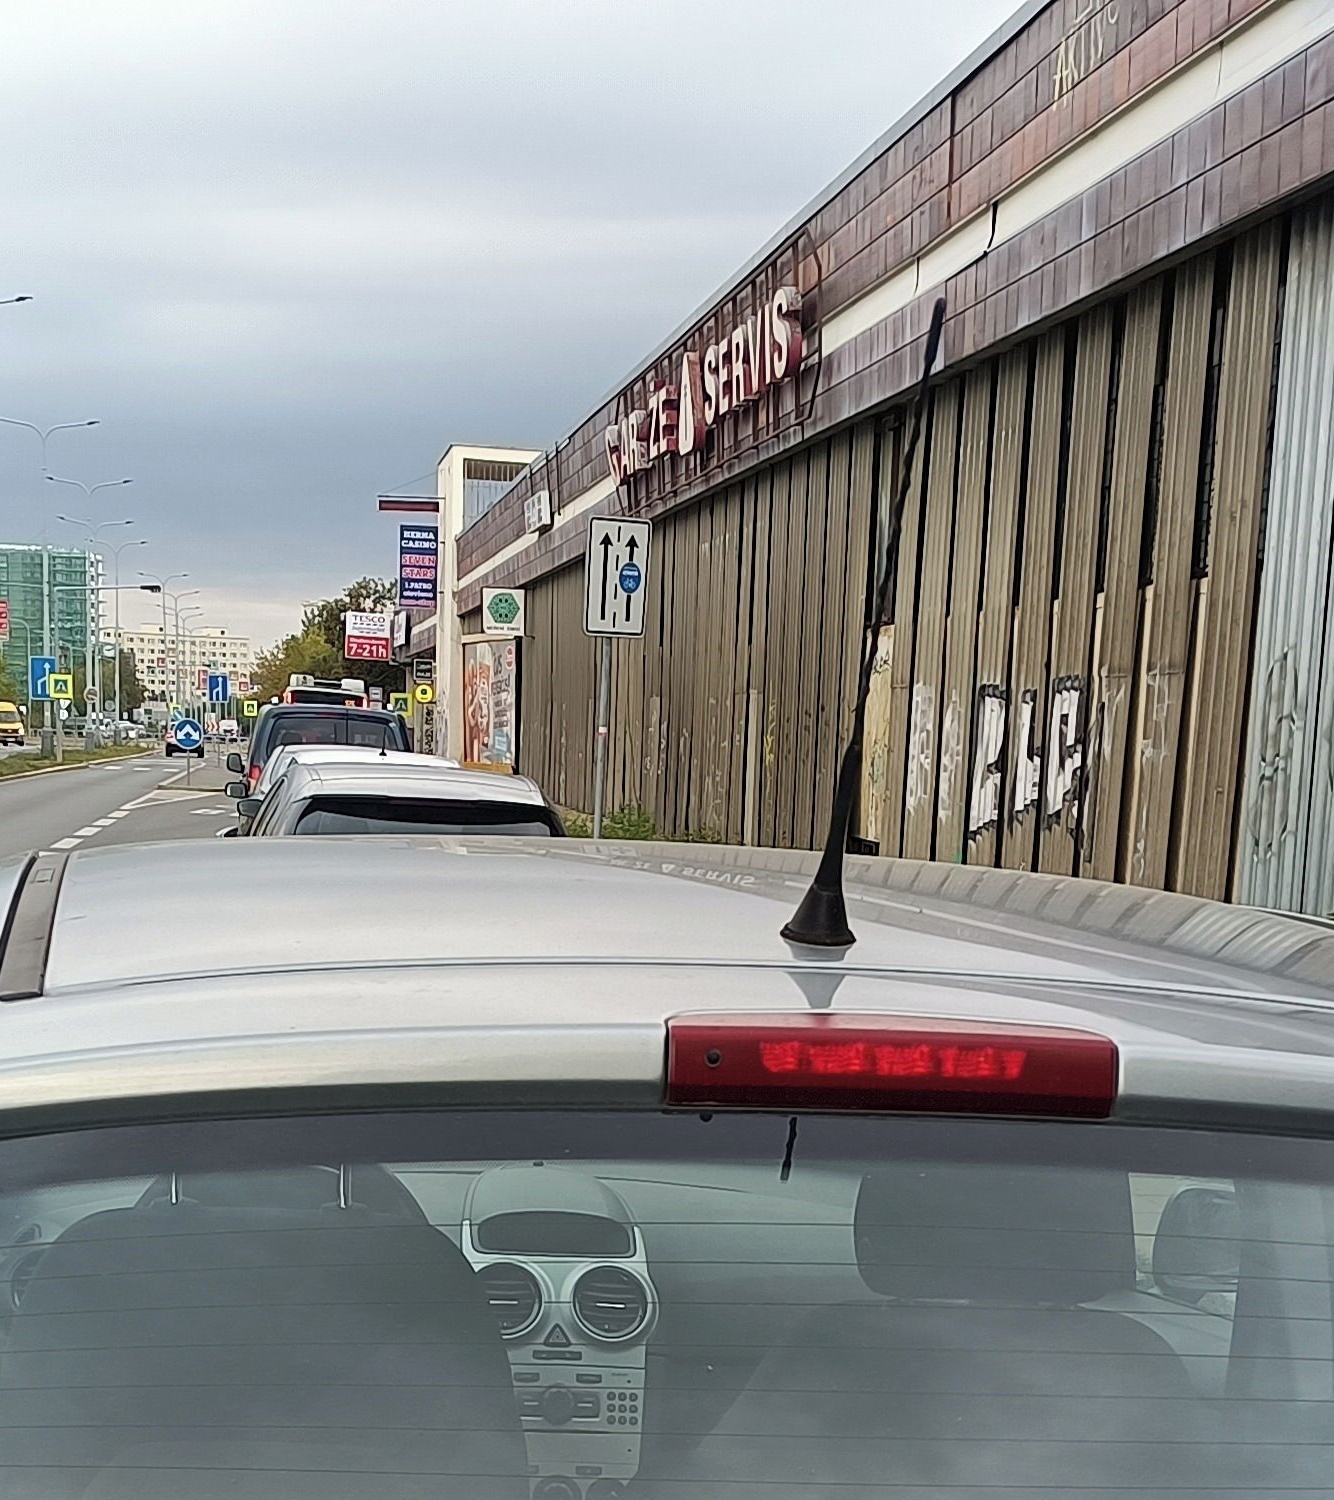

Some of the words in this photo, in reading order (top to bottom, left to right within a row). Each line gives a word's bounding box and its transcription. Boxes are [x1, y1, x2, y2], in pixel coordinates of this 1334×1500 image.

[704, 285, 800, 426] SERVIS
[403, 530, 435, 540] HERNA
[401, 540, 437, 549] CASINO
[402, 554, 436, 567] SEVEN
[402, 567, 435, 579] STARS
[352, 614, 386, 624] TESCO
[349, 643, 387, 658] 7-21h
